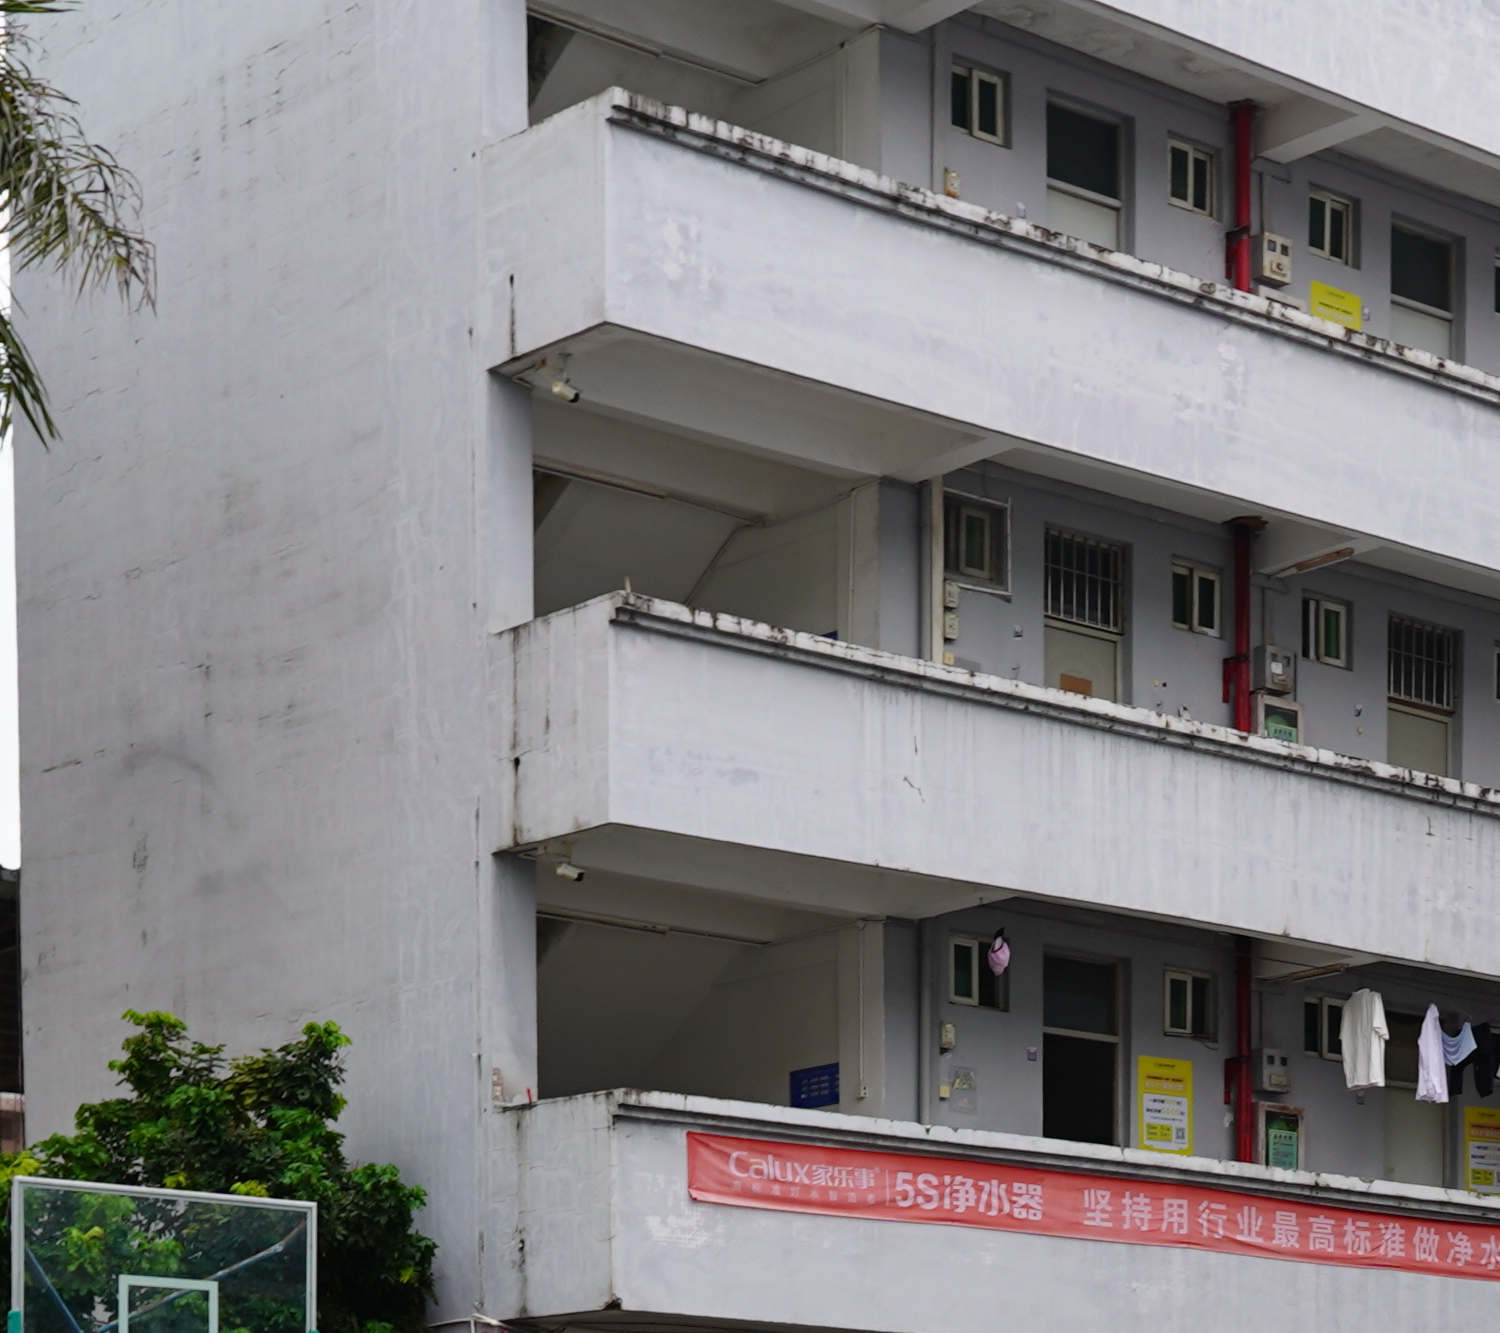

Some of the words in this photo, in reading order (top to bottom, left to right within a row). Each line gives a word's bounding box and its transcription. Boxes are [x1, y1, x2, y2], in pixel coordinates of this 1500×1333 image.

[729, 1150, 811, 1185] Calux
[812, 1163, 876, 1189] 家乐事
[894, 1171, 1044, 1221] 5S净水器
